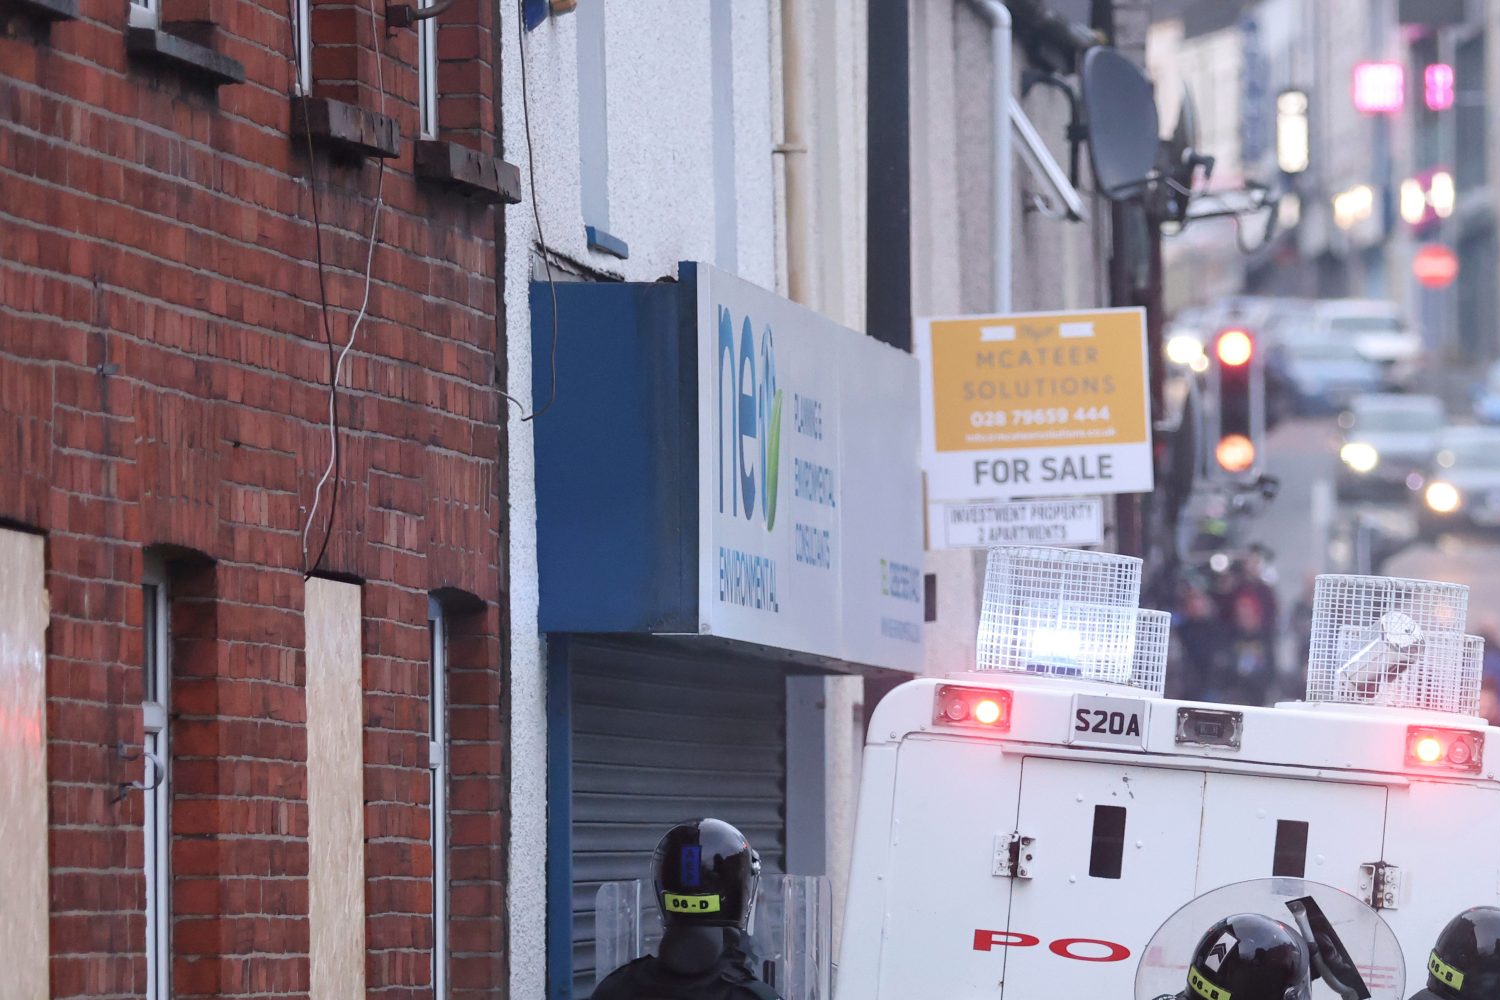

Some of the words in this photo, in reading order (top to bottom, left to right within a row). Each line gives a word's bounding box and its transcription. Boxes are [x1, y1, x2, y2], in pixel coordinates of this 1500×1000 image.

[976, 346, 1099, 369] MCATEER
[963, 375, 1116, 401] SOLUTIONS
[1073, 405, 1110, 422] 444
[974, 459, 1030, 486] FOR
[1041, 454, 1113, 481] SALE
[951, 505, 1026, 525] INVESTMENT
[1030, 503, 1093, 522] PROPERTY
[988, 524, 1067, 542] APARTMENTS
[719, 546, 779, 613] ENVIRONMENTAL
[1075, 708, 1140, 737] S20A
